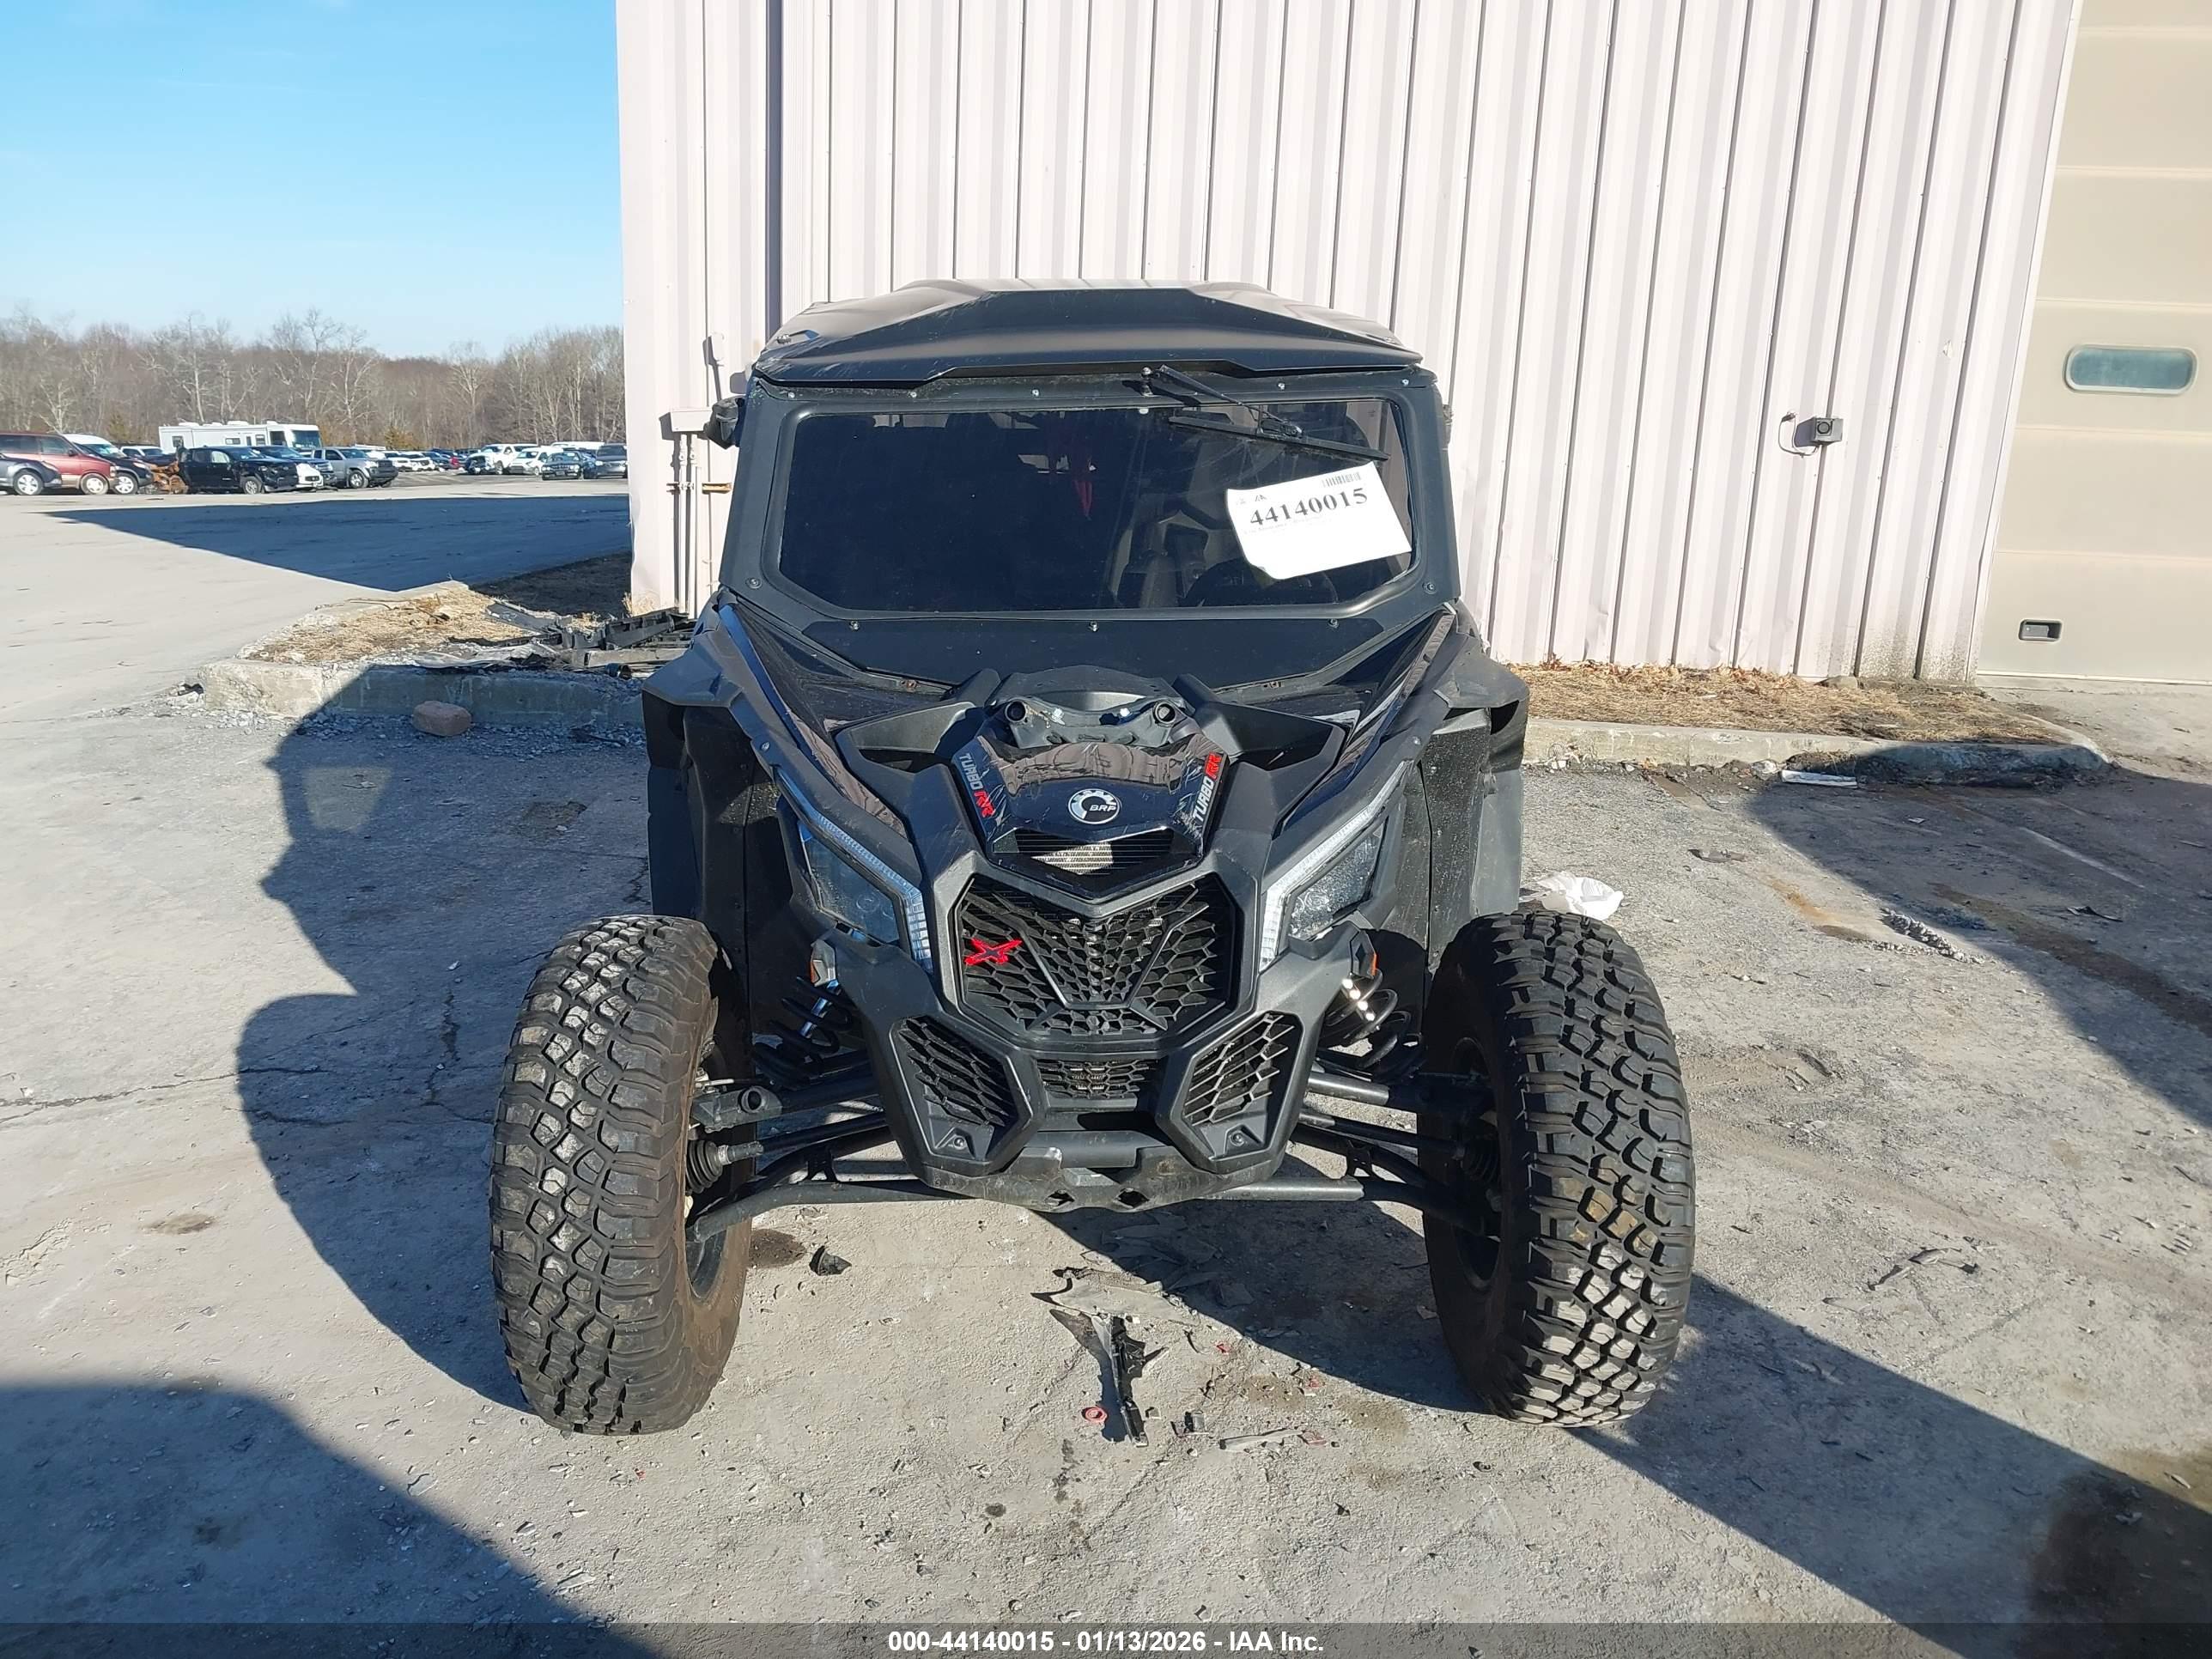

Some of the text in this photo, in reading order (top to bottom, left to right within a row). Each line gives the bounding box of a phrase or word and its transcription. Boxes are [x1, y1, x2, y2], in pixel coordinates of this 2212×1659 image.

[1250, 488, 1368, 526] 44140015
[959, 752, 983, 790] TURBO
[1193, 752, 1222, 822] TURBO RR
